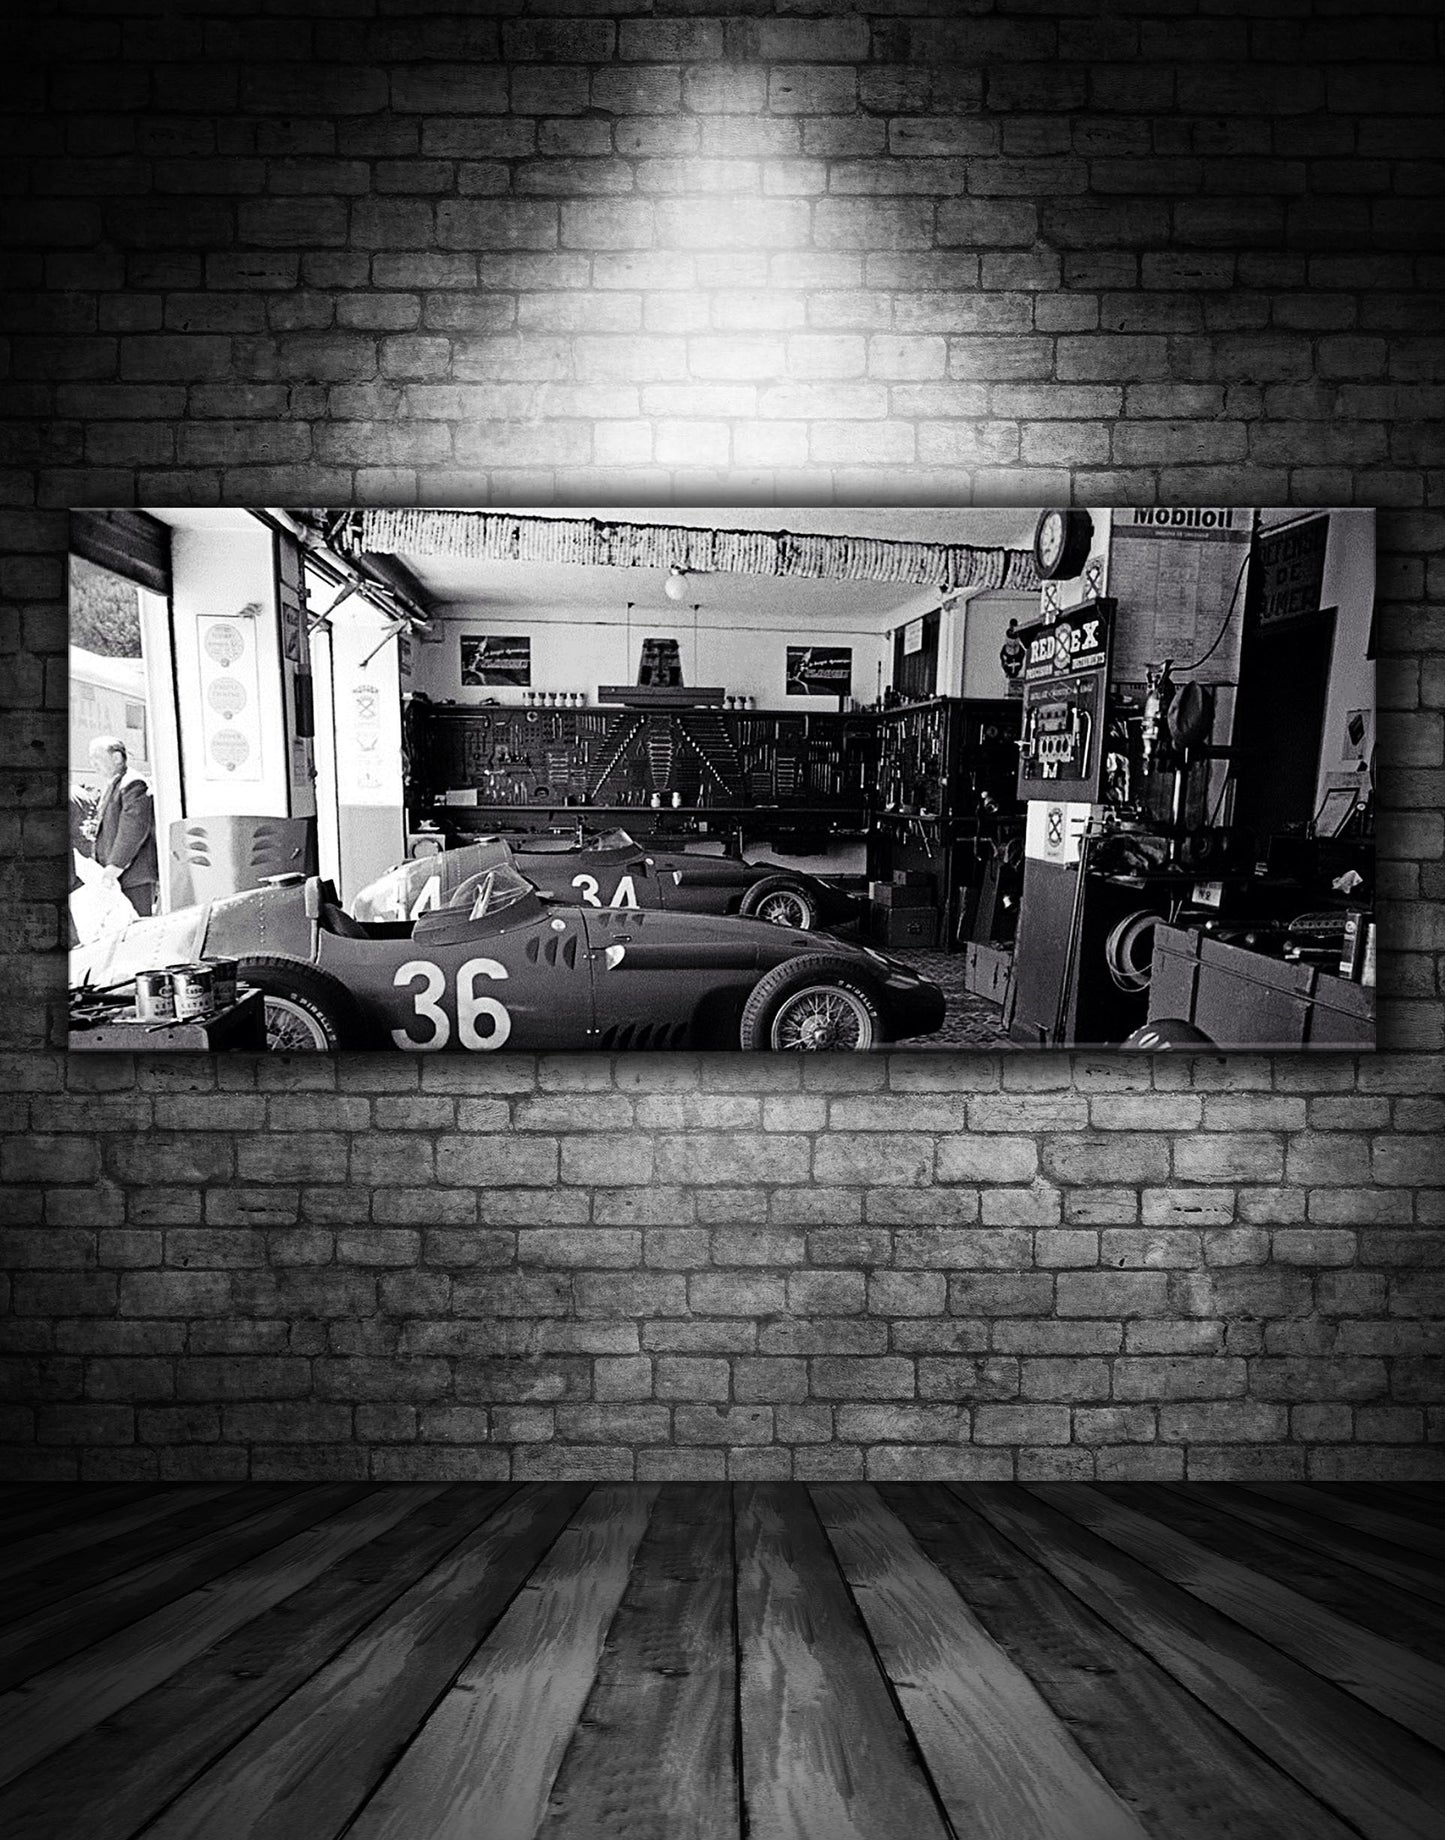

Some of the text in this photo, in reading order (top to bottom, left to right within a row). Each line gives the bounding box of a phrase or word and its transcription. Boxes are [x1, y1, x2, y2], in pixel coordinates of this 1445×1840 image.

[571, 873, 641, 909] 34
[299, 997, 333, 1033] PIRELLI
[391, 957, 512, 1051] 36
